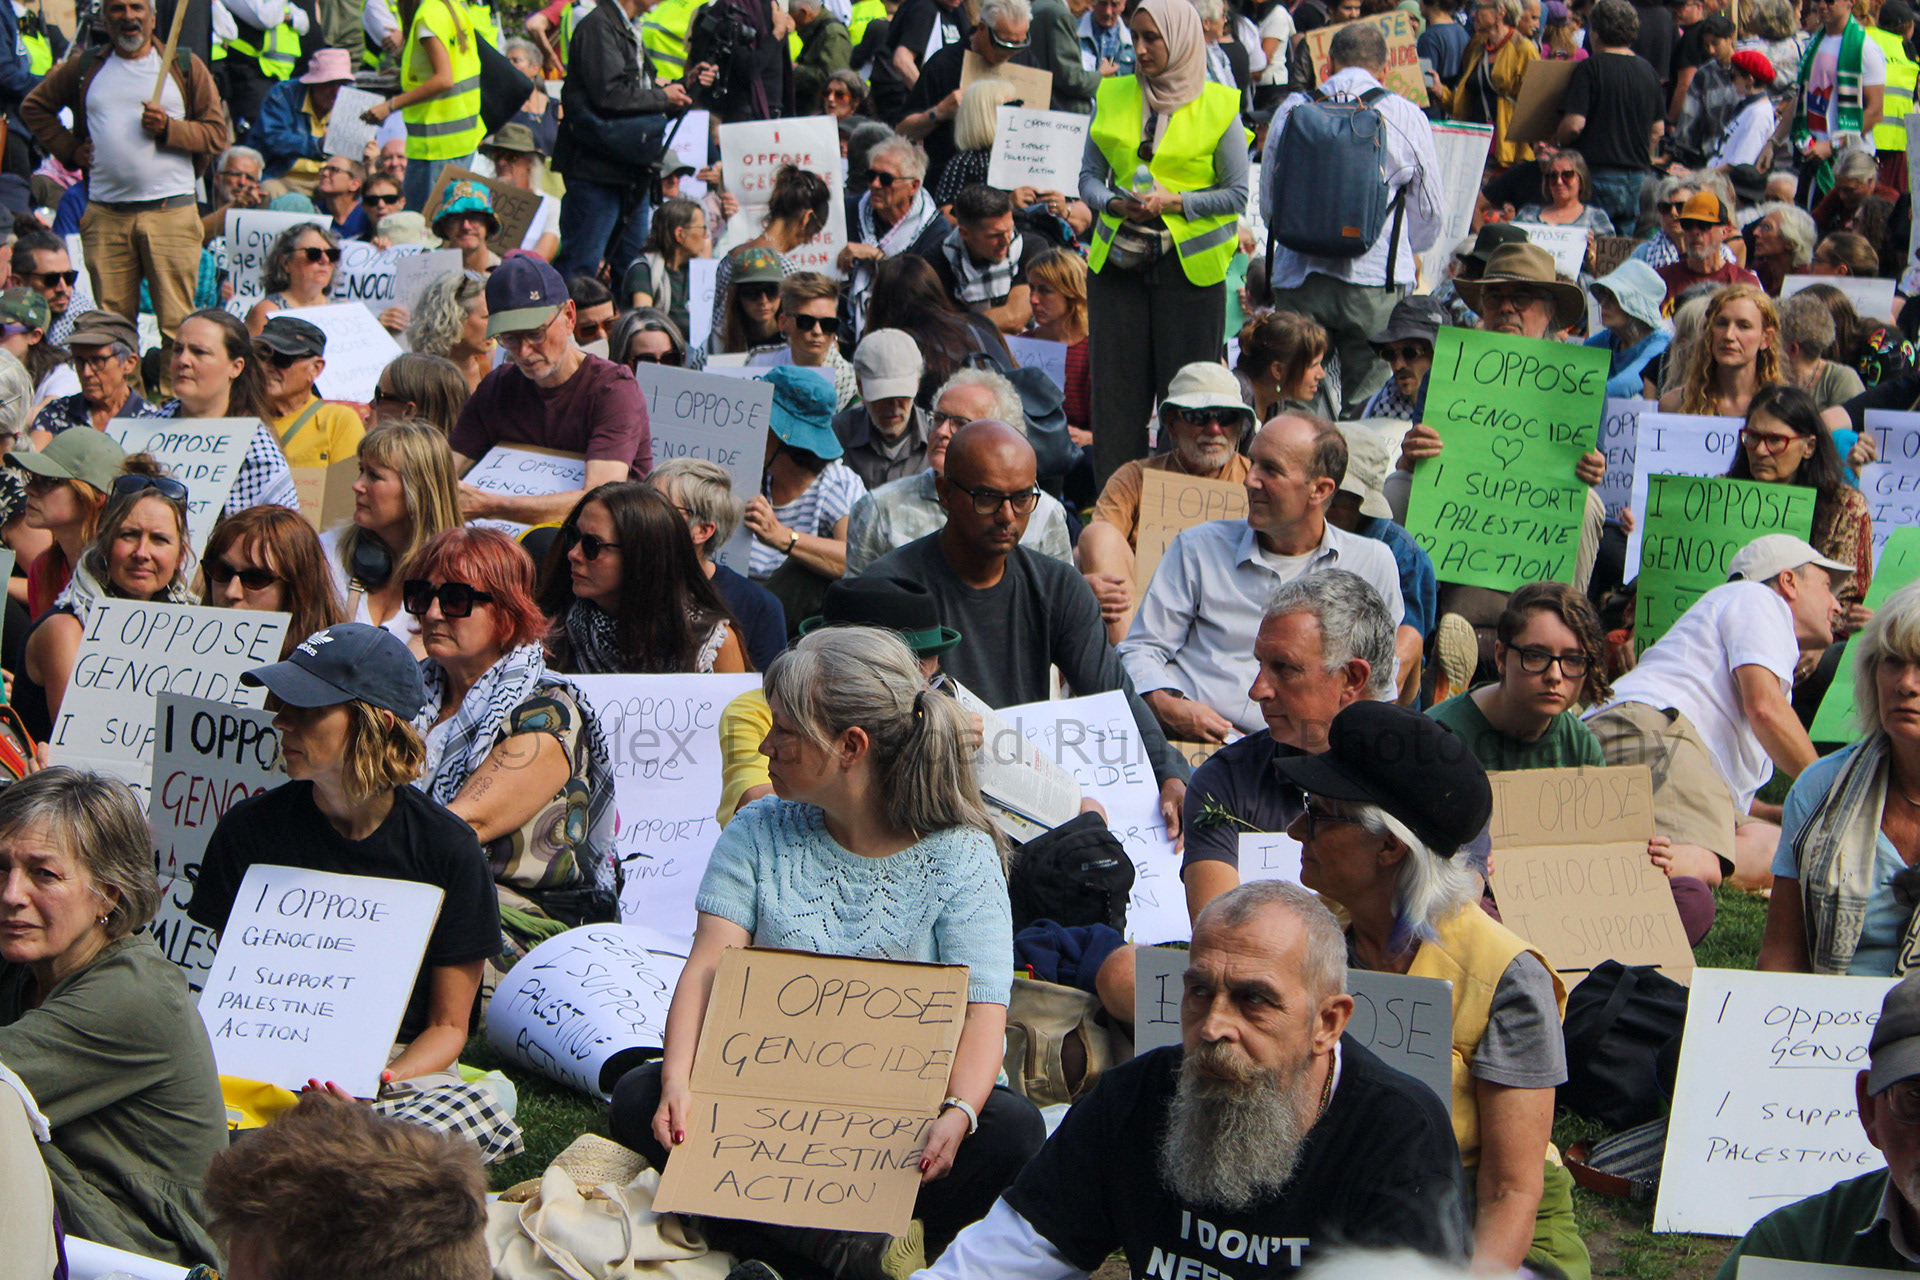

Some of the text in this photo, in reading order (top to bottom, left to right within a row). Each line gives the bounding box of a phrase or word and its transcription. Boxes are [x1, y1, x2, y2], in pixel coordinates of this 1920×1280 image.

[1453, 341, 1600, 396] I OPPOSE
[652, 385, 763, 430] I OPPOSE
[1447, 398, 1593, 449] GENOCIDE
[147, 433, 231, 454] OPPOSE
[651, 437, 742, 466] ENOCIDE
[1650, 427, 1668, 453] I
[1874, 427, 1893, 464] I
[519, 459, 586, 482] OPPOSE
[1434, 463, 1443, 488] I
[1465, 472, 1582, 513] SUPPORT
[1649, 478, 1808, 532] I OPPOSE
[1434, 501, 1578, 547] PALESTINE
[1440, 540, 1565, 581] ACTION
[1642, 596, 1656, 628] I
[86, 606, 280, 663] I OPPOSE
[55, 714, 75, 746] I
[165, 705, 174, 754] I
[1025, 718, 1129, 747] PPOSE
[1490, 776, 1644, 839] I OPPOSE
[618, 816, 714, 844] UPPORT
[1257, 845, 1279, 870] I
[1502, 853, 1660, 902] GENOCIDE
[255, 884, 390, 922] I OPPOSE
[241, 926, 357, 953] GENOCIDE
[1561, 912, 1675, 956] SUPPORT
[228, 966, 357, 990] I SUPPORT
[739, 966, 957, 1024] I OPPOSE
[218, 991, 336, 1018] PALESTINE
[1717, 991, 1731, 1024] I
[216, 1018, 311, 1043] ACTION
[721, 1032, 953, 1080] GENOCIDE
[711, 1103, 938, 1142] I SUPPORT
[1715, 1091, 1731, 1117] I
[712, 1134, 924, 1172] PALESTINE
[1706, 1136, 1872, 1165] PALESTINE
[713, 1170, 877, 1204] ACTION
[1180, 1209, 1311, 1268] I DON'T
